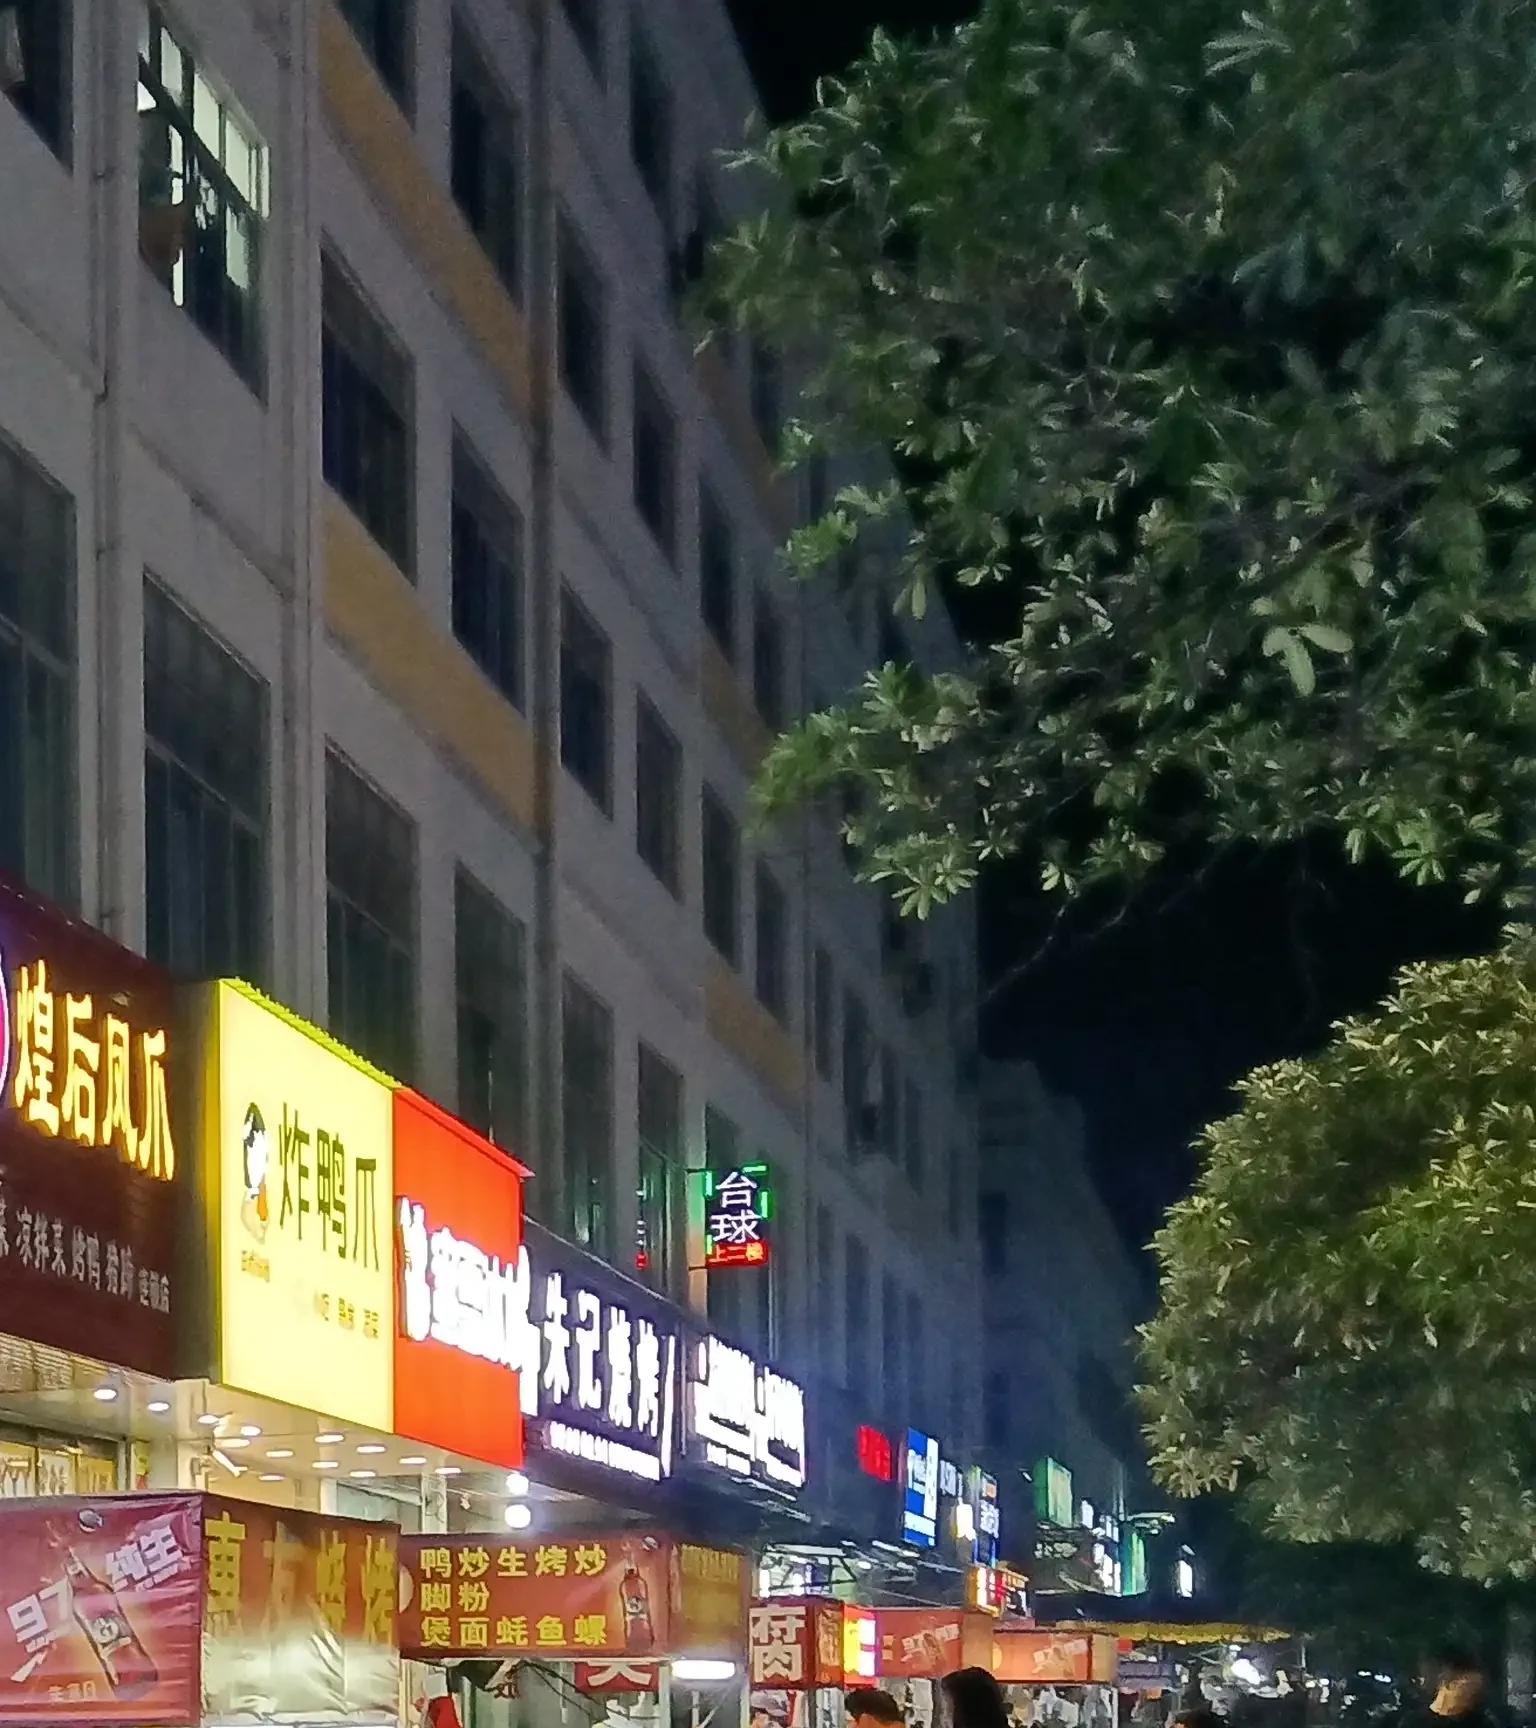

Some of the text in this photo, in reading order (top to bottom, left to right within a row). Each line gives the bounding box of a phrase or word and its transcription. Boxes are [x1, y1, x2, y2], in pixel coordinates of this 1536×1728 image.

[14, 959, 175, 1181] 煌后凤爪
[710, 1171, 762, 1243] 台球
